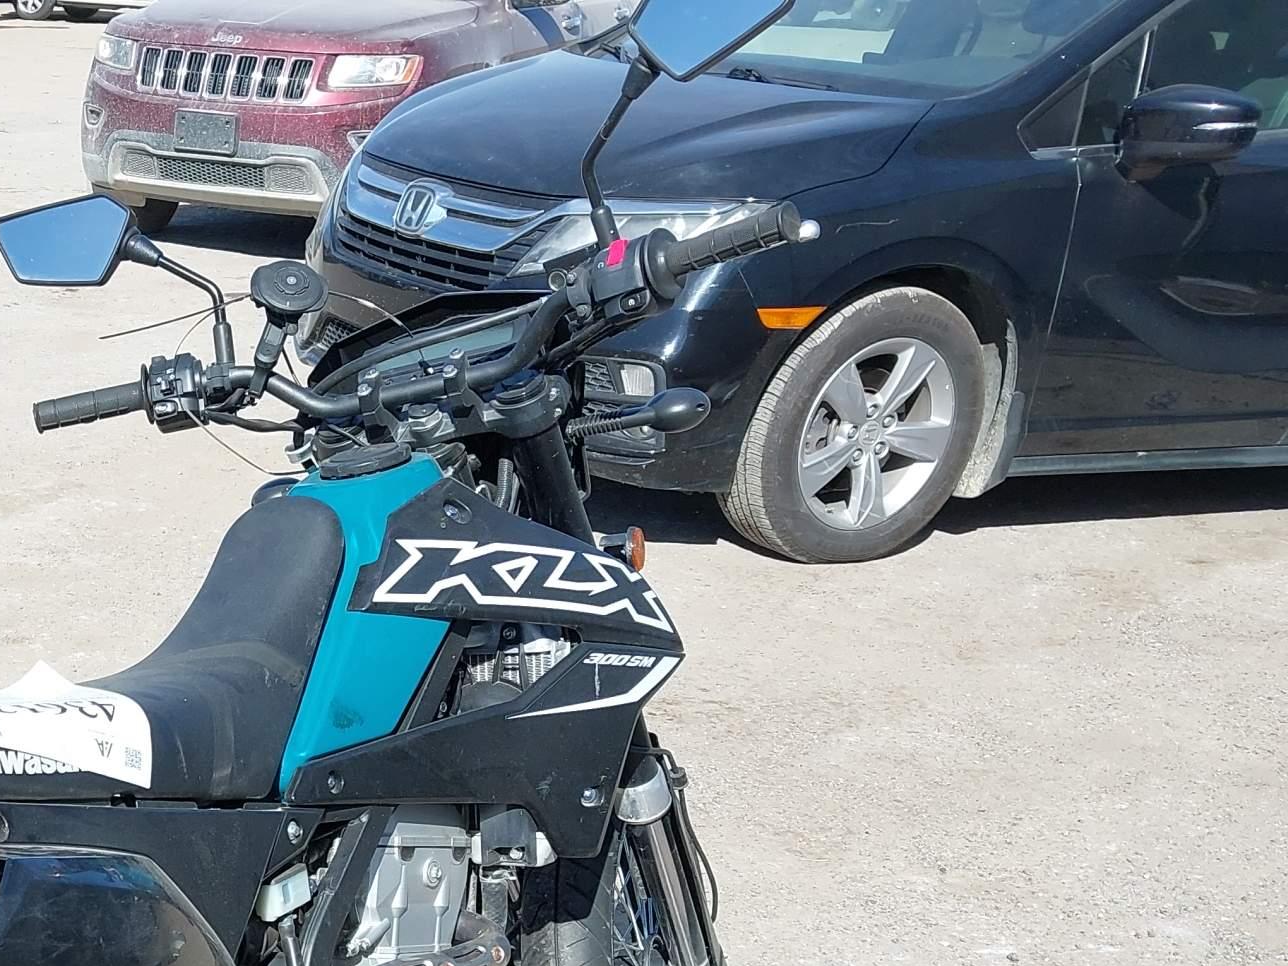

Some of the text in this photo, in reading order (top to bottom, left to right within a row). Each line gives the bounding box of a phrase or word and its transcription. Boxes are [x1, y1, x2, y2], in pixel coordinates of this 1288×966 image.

[211, 31, 243, 46] Jeep
[372, 539, 676, 633] KLX
[583, 652, 657, 668] 300SM
